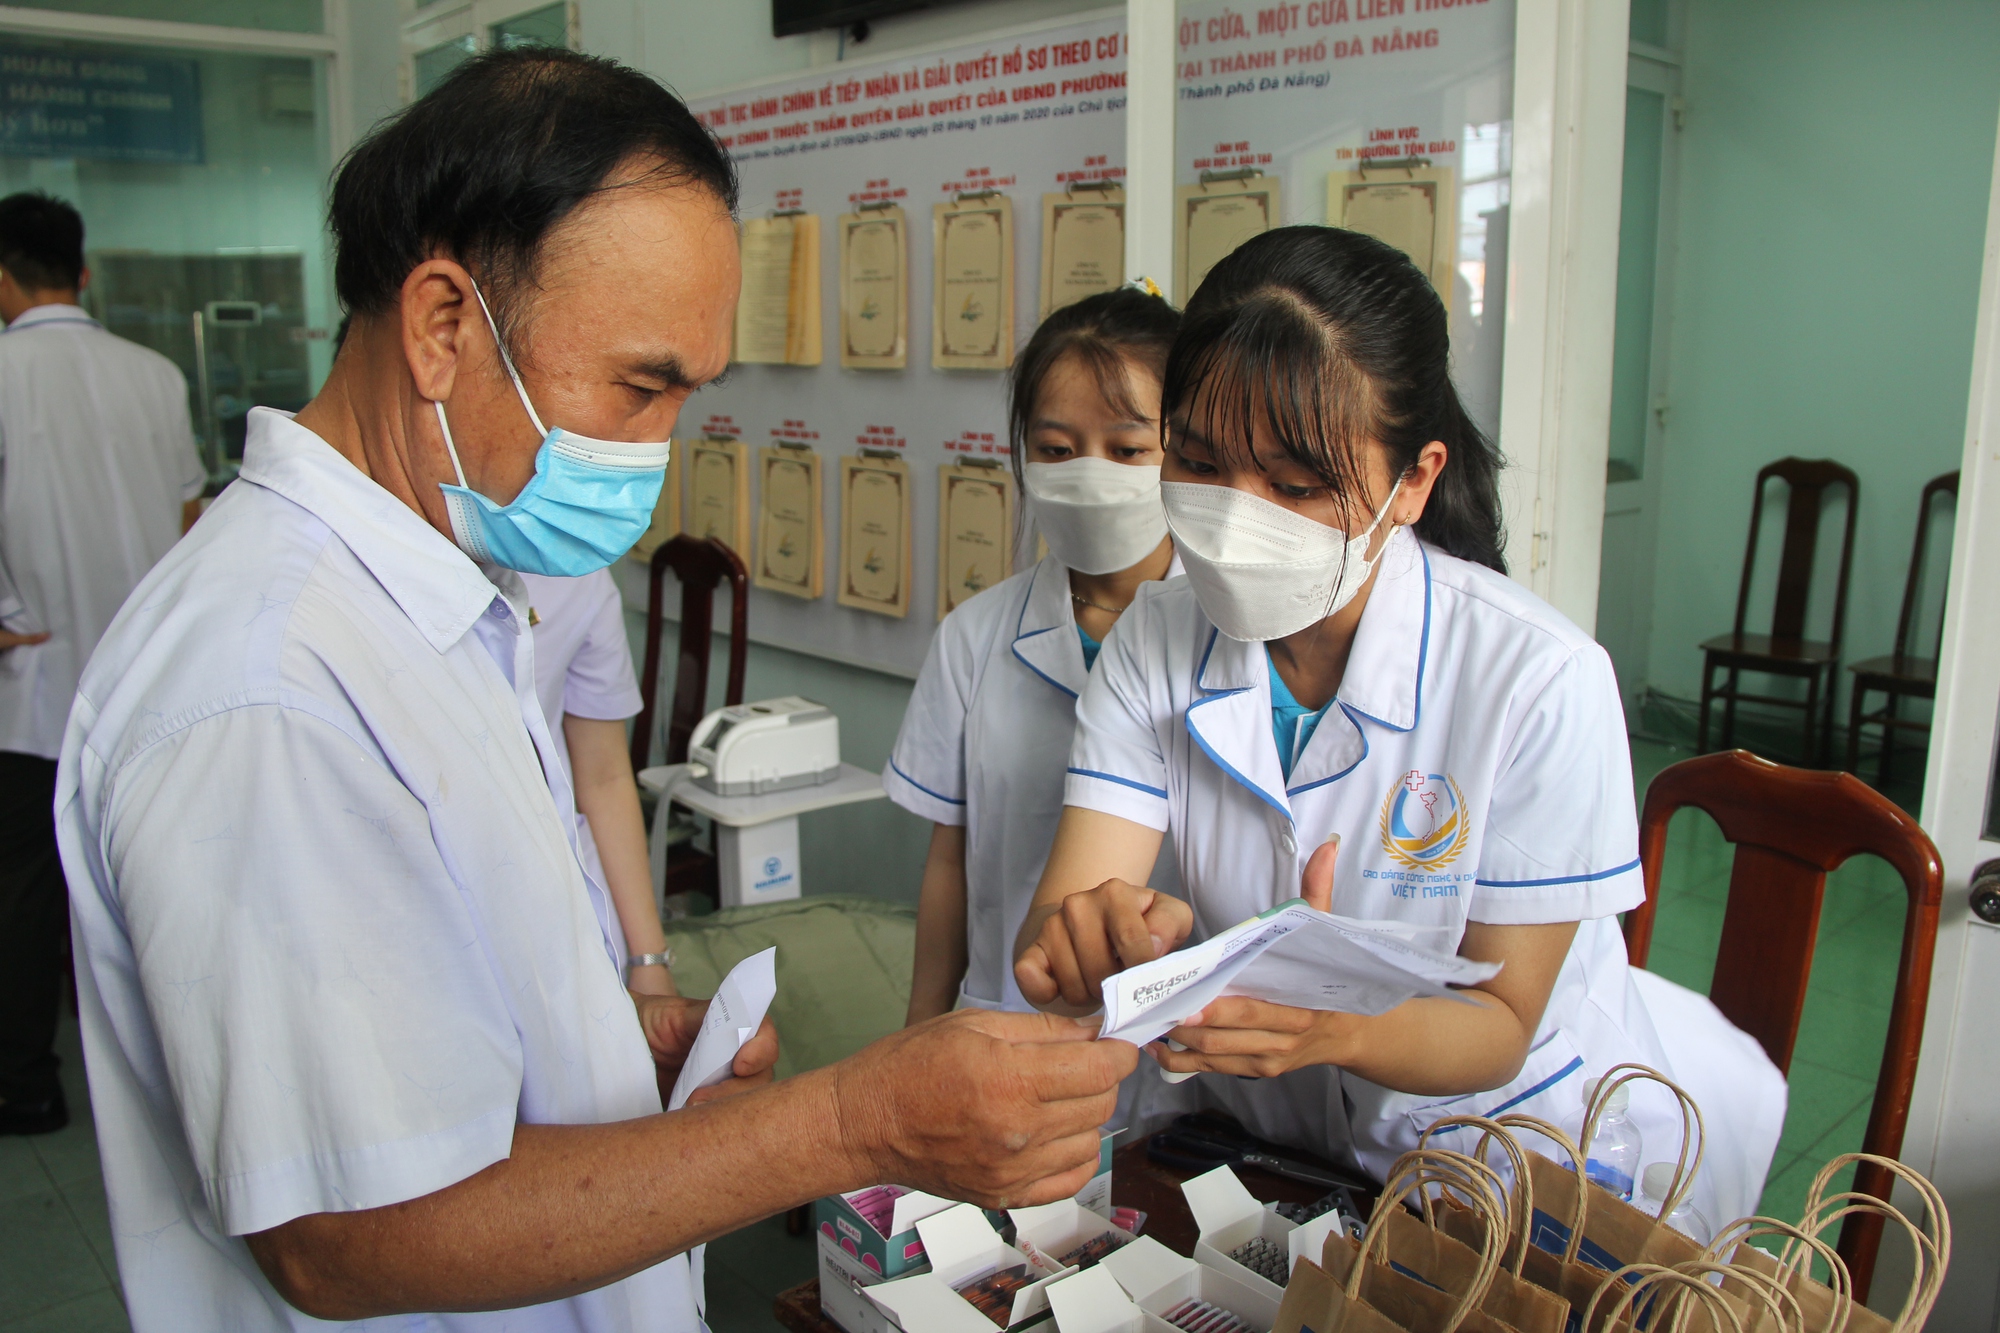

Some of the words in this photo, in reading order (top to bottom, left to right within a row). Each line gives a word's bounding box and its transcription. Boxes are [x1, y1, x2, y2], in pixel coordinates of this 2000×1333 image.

[751, 95, 778, 119] HÀNH
[782, 87, 816, 114] CHÍNH
[819, 79, 833, 107] VỀ
[836, 76, 862, 104] TIẾP
[865, 70, 900, 102] NHẬN
[903, 66, 920, 92] VÀ
[924, 57, 951, 89] GIẢI
[955, 49, 998, 84] QUYẾT
[1002, 43, 1023, 76] HỒ
[1027, 44, 1049, 71] SƠ
[1052, 38, 1091, 67] THEO
[1096, 32, 1119, 59] CƠ
[1207, 6, 1251, 42] CỬA,
[1257, 2, 1301, 38] MỘT
[851, 106, 893, 129] QUYỀN
[897, 98, 924, 120] GIẢI
[928, 94, 972, 117] QUYẾT
[977, 86, 1007, 109] CỦA
[1012, 82, 1056, 103] UBND
[1210, 50, 1277, 76] THÀNH
[1283, 37, 1327, 67] PHỐ
[1334, 34, 1365, 60] ĐÀ
[1372, 26, 1440, 55] NẴNG
[905, 124, 928, 139] ngày
[947, 116, 976, 132] tháng
[980, 113, 993, 126] 10
[996, 110, 1020, 125] năm
[1022, 106, 1050, 121] 2020
[1053, 102, 1075, 117] của
[1078, 97, 1104, 114] Chủ
[1179, 83, 1222, 100] Thành
[1226, 78, 1256, 98] phố
[1259, 76, 1280, 92] Đà
[1284, 70, 1331, 88] Nẵng)
[1369, 127, 1394, 142] LĨNH
[1398, 126, 1419, 141] VỰC
[1336, 145, 1352, 159] TÍN
[1404, 141, 1425, 155] TÔN
[1429, 138, 1455, 153] GIÁO
[1363, 869, 1378, 879] CAO
[1406, 872, 1425, 883] CÔNG
[1391, 883, 1417, 899] VIỆT
[1422, 885, 1459, 898] NAM
[1137, 988, 1171, 1008] Smart
[825, 1255, 849, 1281] NEUTRI
